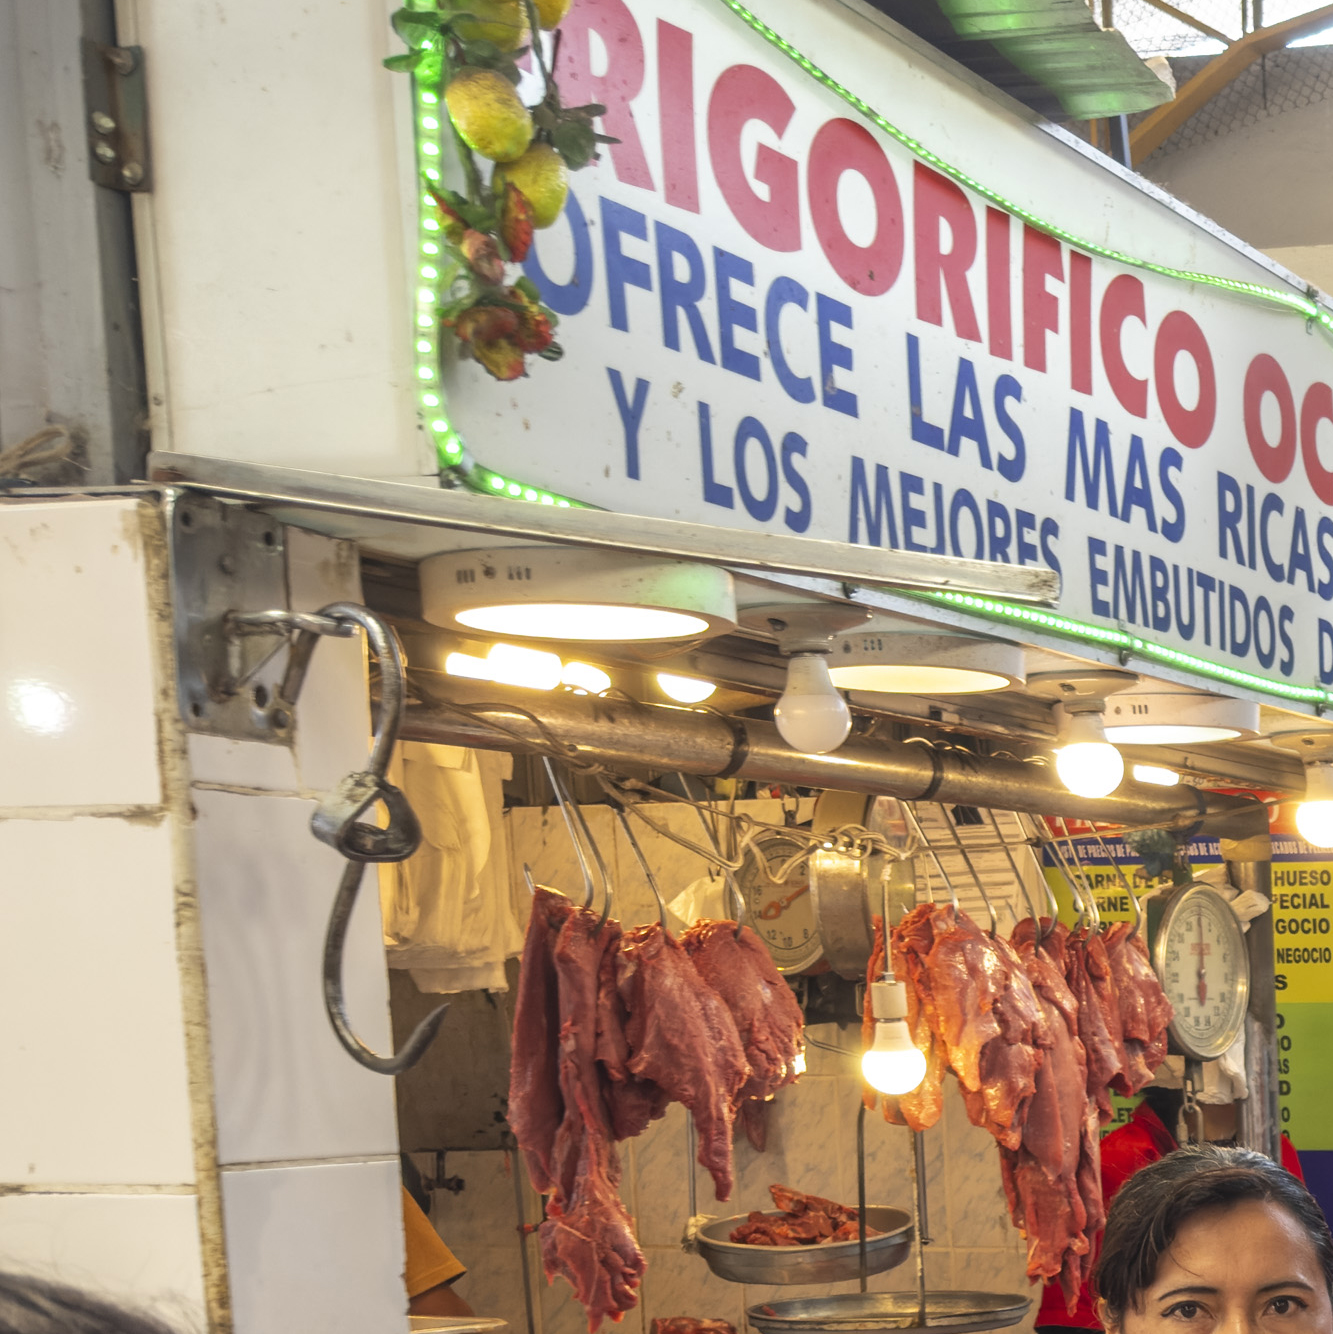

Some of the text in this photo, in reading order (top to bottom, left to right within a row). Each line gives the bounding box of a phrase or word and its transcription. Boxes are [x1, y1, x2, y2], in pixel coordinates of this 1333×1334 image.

[508, 0, 1217, 449] RIGORIFICO
[522, 187, 859, 419] OFRECE
[907, 332, 1026, 482] LAS
[1065, 406, 1185, 543] MAS
[606, 367, 650, 481] Y
[697, 401, 812, 533] LOS
[847, 455, 1063, 598] MEJORES
[1088, 536, 1295, 677] EMBUTIDOS
[1274, 870, 1331, 887] HUESO
[1277, 947, 1331, 963] NEGOCIO
